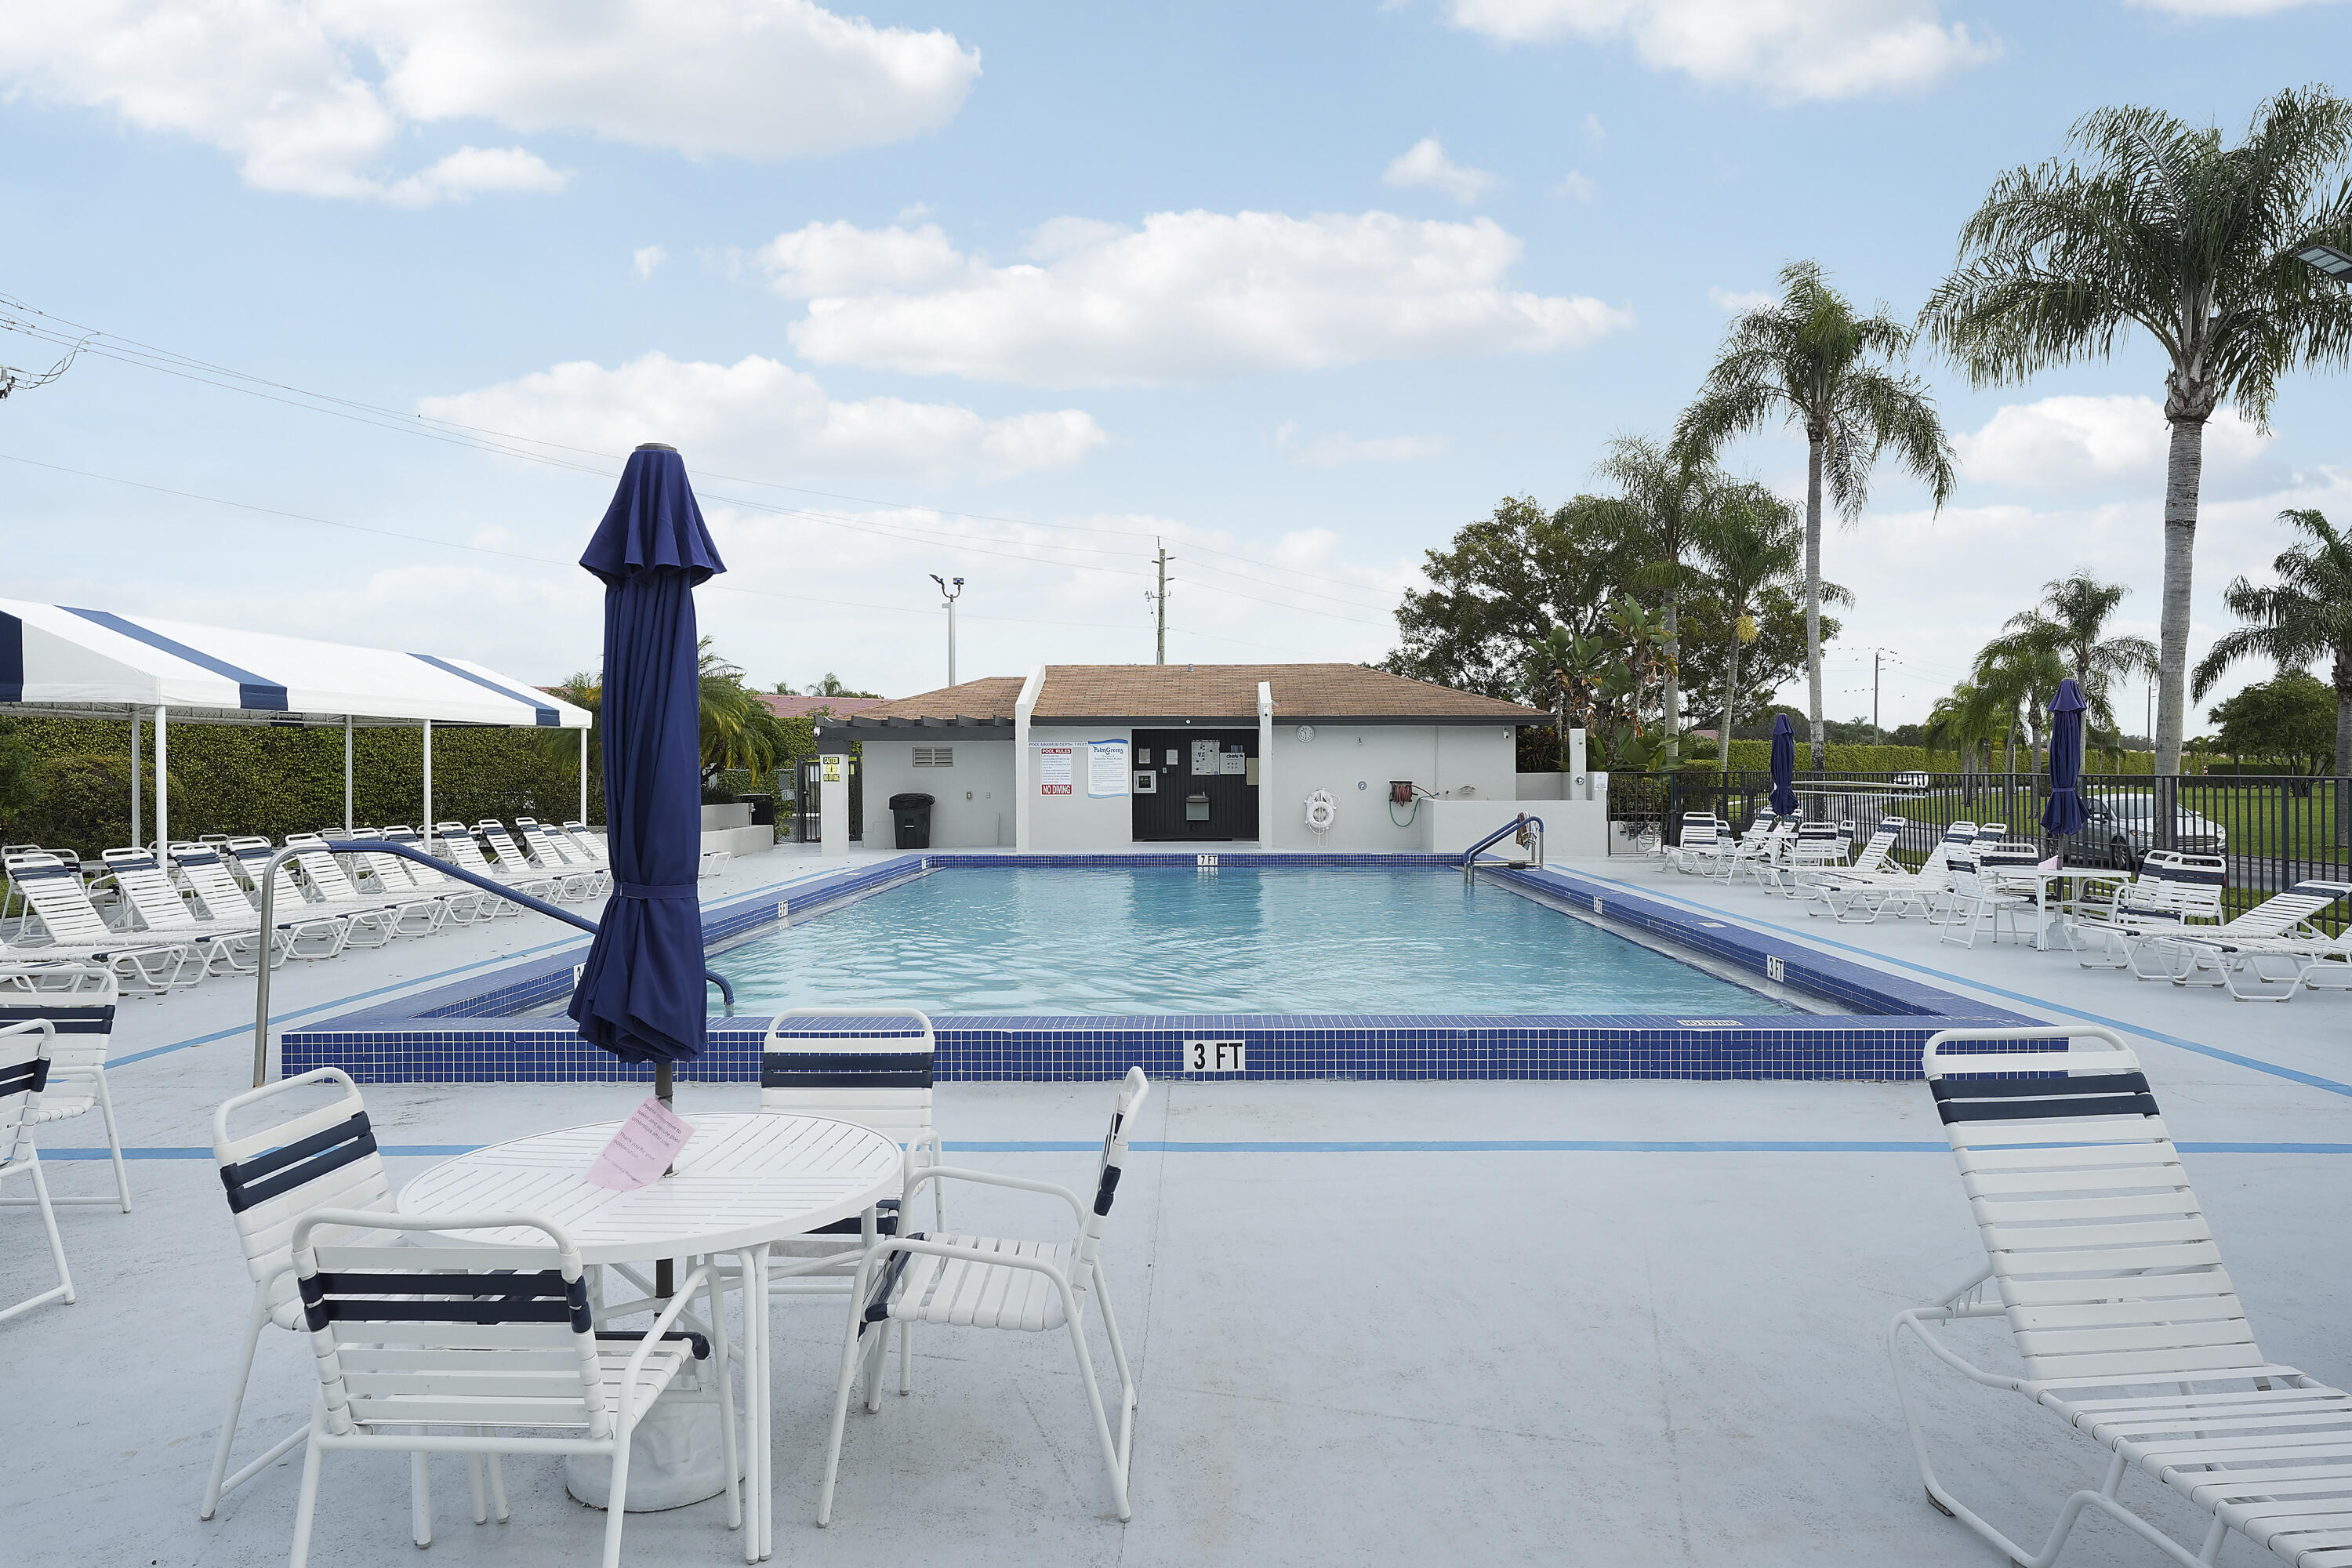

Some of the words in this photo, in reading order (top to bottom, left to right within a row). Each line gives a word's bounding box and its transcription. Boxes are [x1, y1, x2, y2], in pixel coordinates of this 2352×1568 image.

[1043, 786, 1051, 794] NO
[1052, 786, 1071, 794] DIVING
[1201, 855, 1205, 864] 7
[1208, 855, 1217, 864] FT
[1769, 956, 1773, 976] 3
[1775, 959, 1783, 981] FT
[1194, 1043, 1206, 1070] 3
[1216, 1043, 1243, 1069] FT
[637, 1109, 649, 1120] lower
[648, 1118, 658, 1127] and
[655, 1124, 671, 1137] secure
[669, 1134, 681, 1145] pool
[642, 1102, 657, 1116] Please
[655, 1112, 677, 1131] remember
[619, 1132, 633, 1143] Thank
[630, 1142, 641, 1150] you
[644, 1152, 655, 1162] your
[652, 1131, 662, 1142] after
